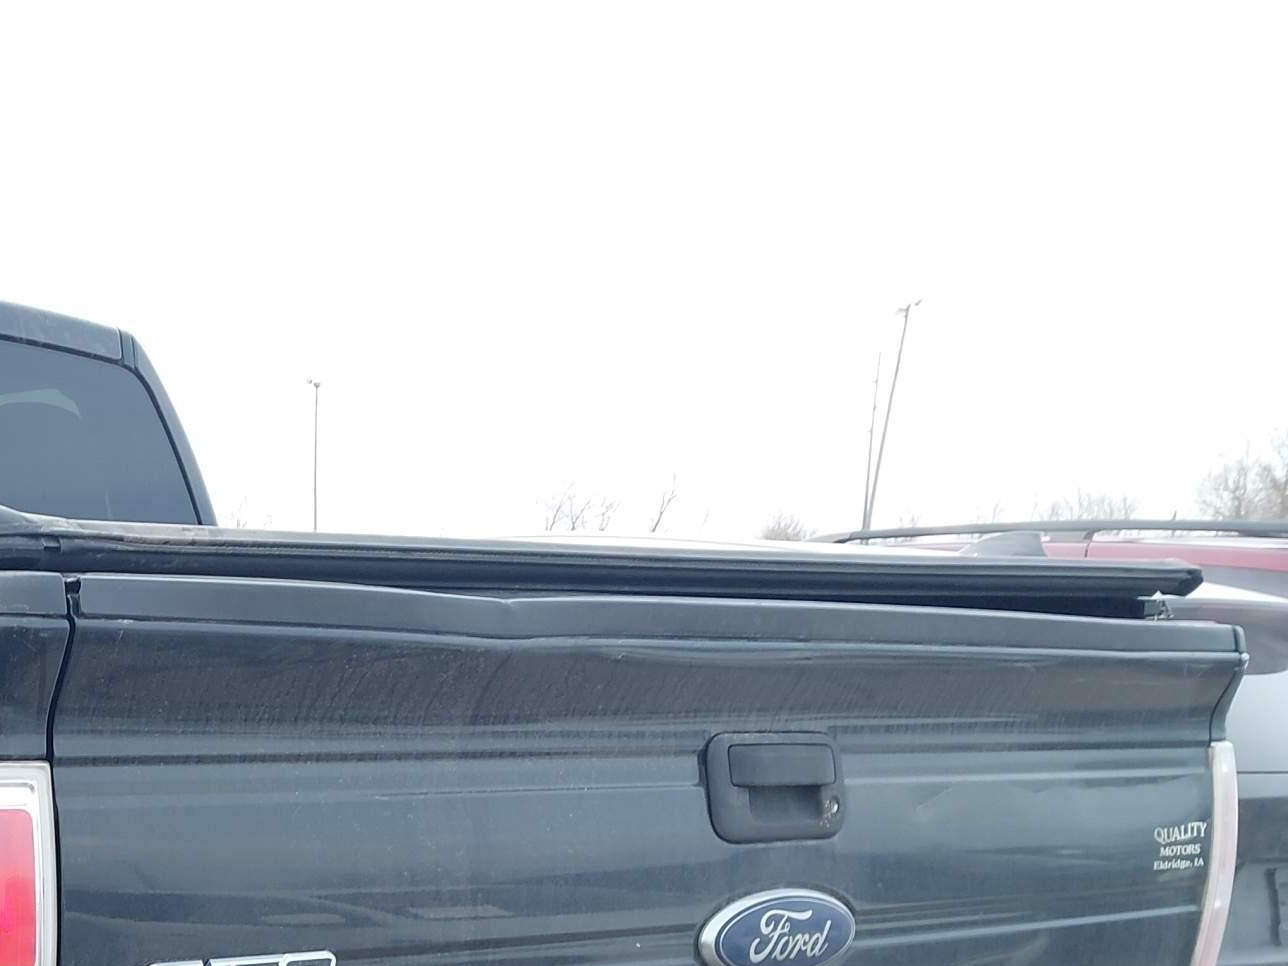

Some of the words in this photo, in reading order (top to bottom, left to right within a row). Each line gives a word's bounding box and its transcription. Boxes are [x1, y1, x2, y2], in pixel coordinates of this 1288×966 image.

[1154, 821, 1207, 845] QUALITY
[1160, 843, 1201, 857] MOTORS
[1194, 857, 1204, 867] IA
[749, 909, 832, 964] Ford
